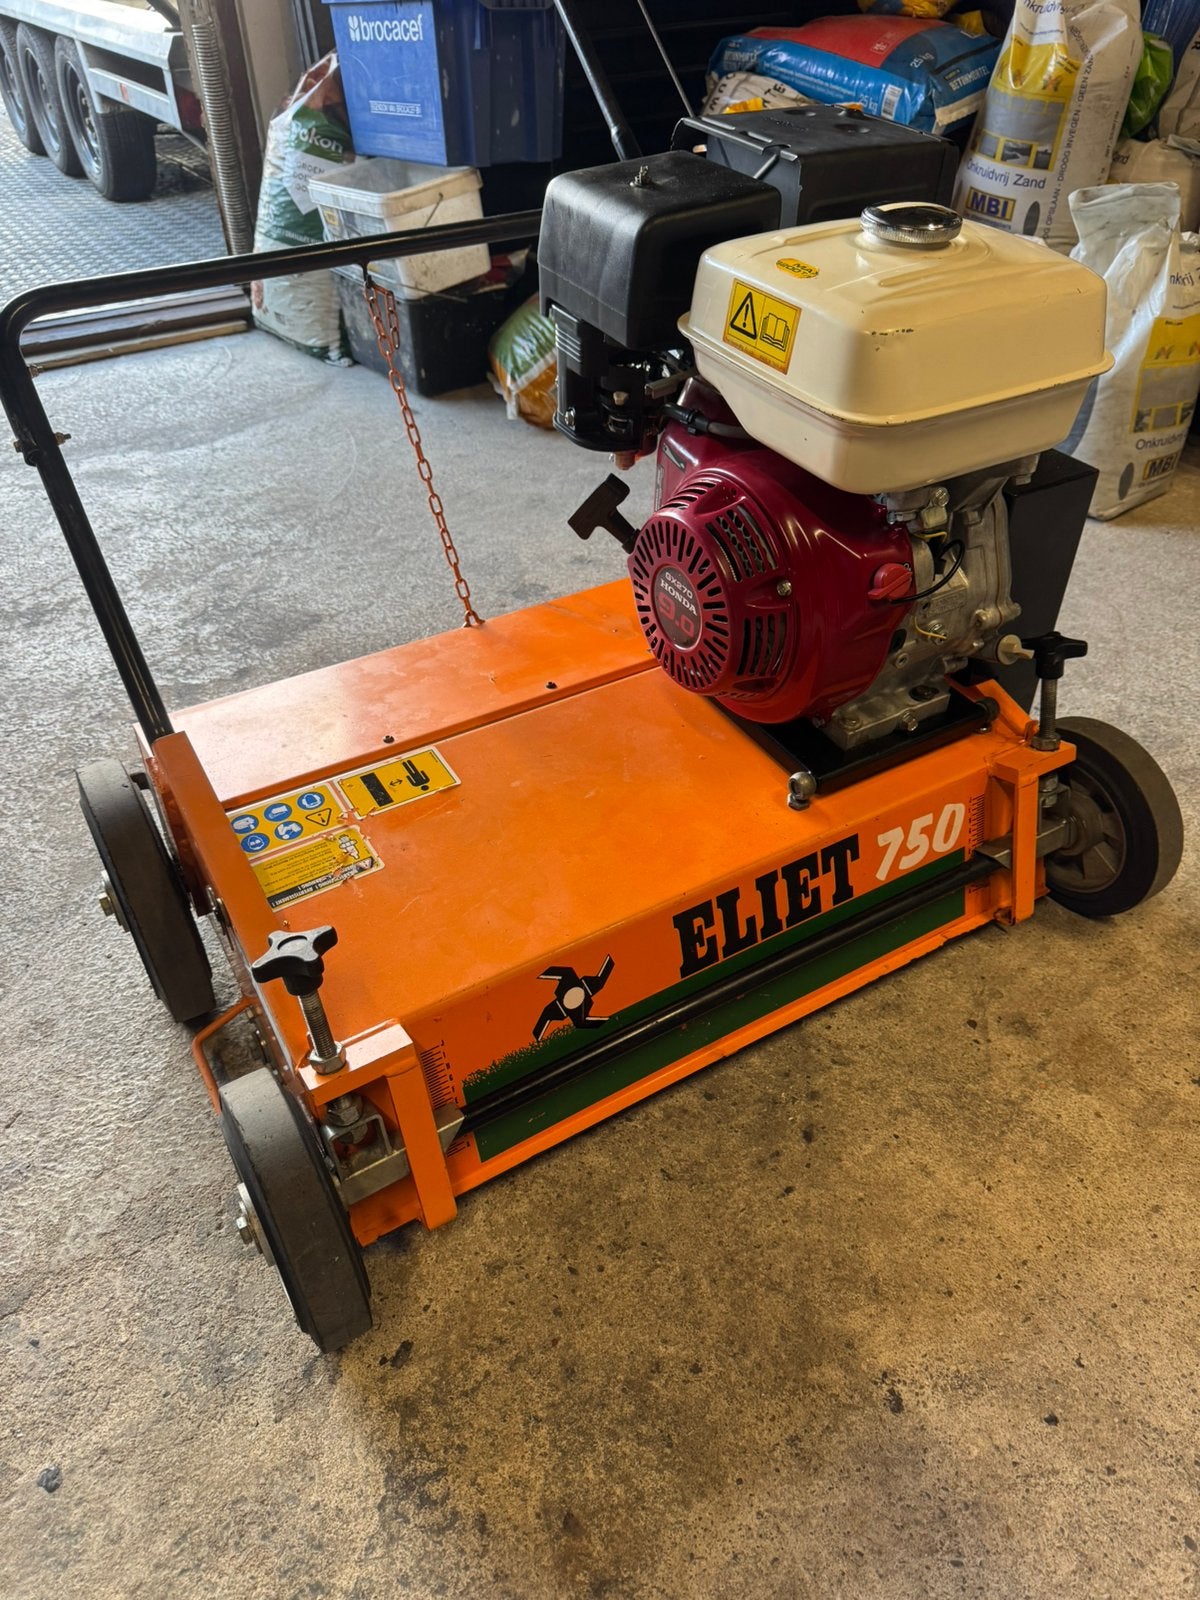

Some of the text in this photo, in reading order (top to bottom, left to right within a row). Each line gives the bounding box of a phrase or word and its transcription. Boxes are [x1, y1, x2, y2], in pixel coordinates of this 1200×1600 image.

[359, 14, 424, 42] brocacef
[289, 119, 344, 154] Pokon
[1046, 187, 1061, 226] OPSLAAN
[1057, 152, 1069, 181] DROOG
[1065, 109, 1081, 148] INVEGEN
[1077, 76, 1089, 102] GEEN
[1012, 173, 1047, 189] Zand
[970, 191, 1009, 219] MBI
[659, 578, 698, 617] HONDA
[665, 571, 693, 600] GX270
[657, 591, 695, 637] 9.0
[875, 802, 966, 882] 750
[672, 832, 860, 979] ELIET
